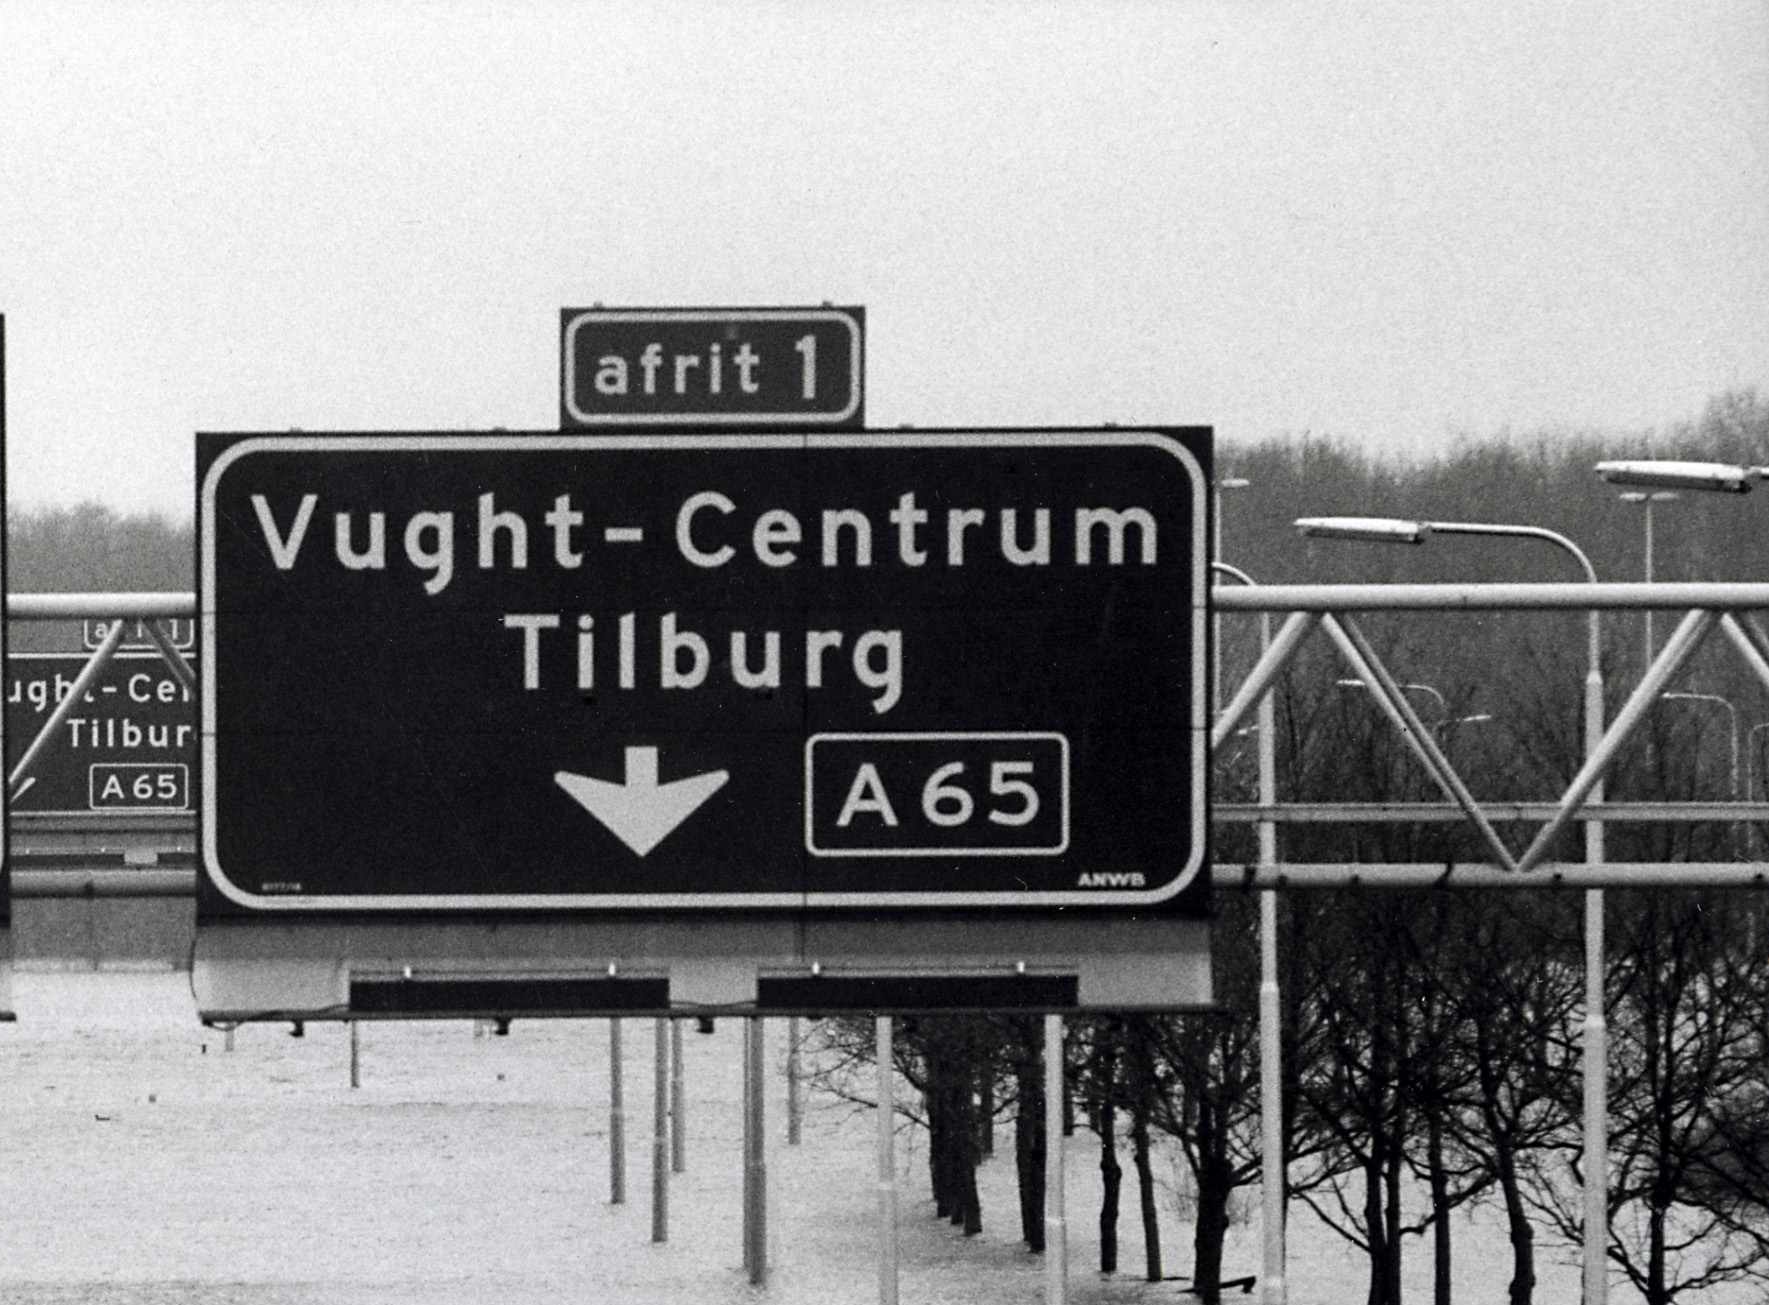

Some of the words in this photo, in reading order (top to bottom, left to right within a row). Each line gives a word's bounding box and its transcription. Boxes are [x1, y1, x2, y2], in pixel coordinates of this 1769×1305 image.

[593, 341, 761, 396] afrit
[793, 334, 818, 401] 1
[250, 490, 1158, 597] Vught-Centrum
[502, 611, 906, 716] Tilburg
[920, 760, 1040, 828] 65
[1076, 871, 1146, 888] ANWB
